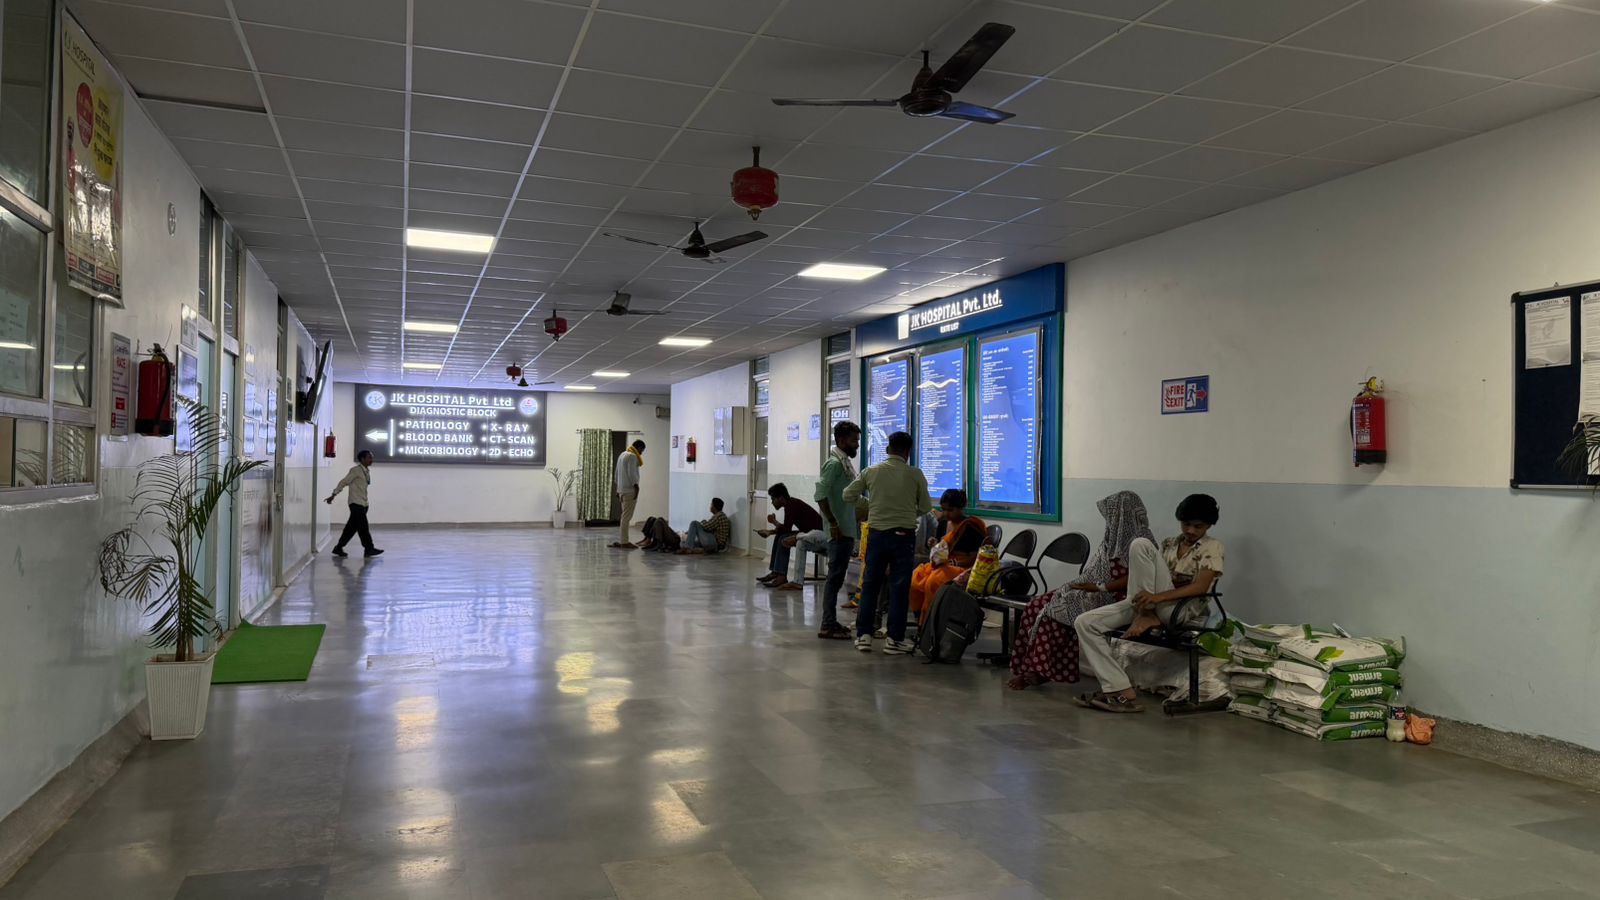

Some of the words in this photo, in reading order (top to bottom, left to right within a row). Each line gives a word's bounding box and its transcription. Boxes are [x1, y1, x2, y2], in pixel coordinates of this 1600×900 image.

[911, 313, 921, 328] JK
[921, 301, 961, 323] HOSPITAL
[963, 296, 980, 313] Pvt.
[983, 289, 1002, 307] Ltd.
[1170, 385, 1184, 395] FIRE
[391, 393, 405, 402] JK
[408, 394, 466, 405] HOSPITAL
[469, 396, 489, 406] Pvt
[493, 397, 512, 407] Ltd
[1170, 397, 1184, 407] EXIT
[409, 406, 466, 416] DIAGNOSTIC
[467, 408, 497, 417] BLOCK
[405, 421, 470, 431] PATHOLOGY
[405, 433, 441, 442] BLOOD
[444, 434, 473, 443] BANK
[507, 435, 536, 445] SCAN
[405, 445, 479, 456] MICROBIOLOGY
[488, 447, 501, 457] 2D
[509, 448, 535, 457] ECHO
[1349, 672, 1382, 683] arment
[1350, 686, 1383, 698] arment
[1349, 710, 1383, 720] arment
